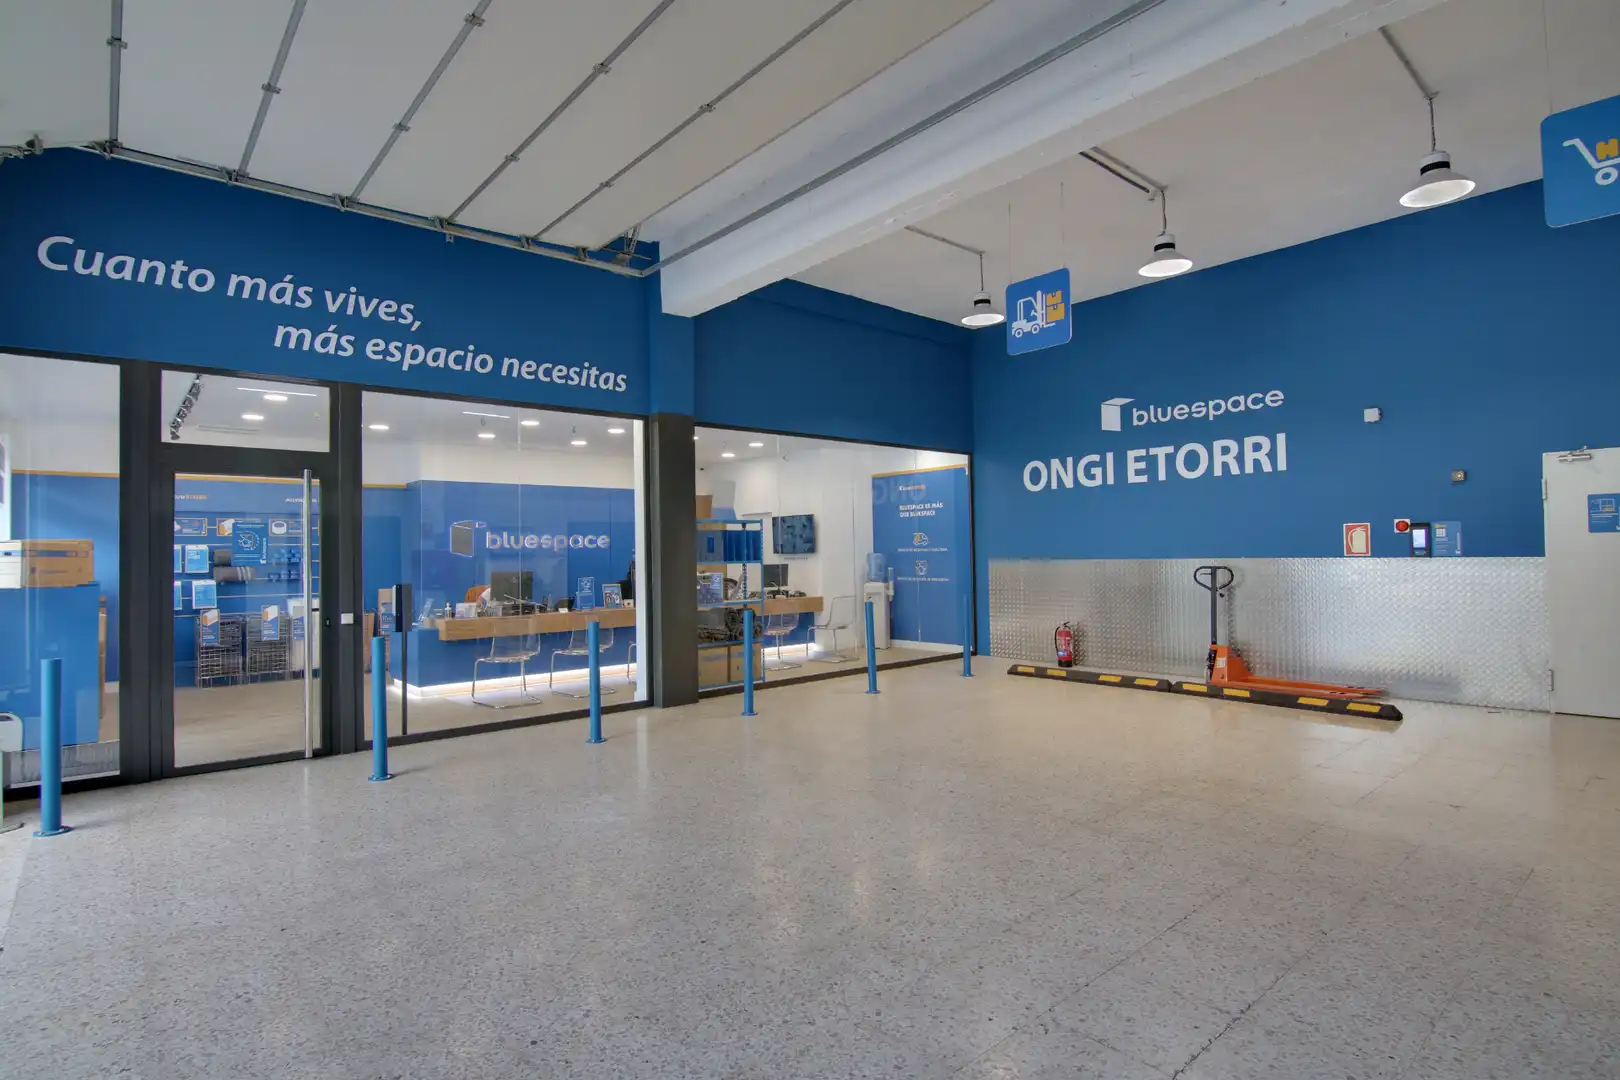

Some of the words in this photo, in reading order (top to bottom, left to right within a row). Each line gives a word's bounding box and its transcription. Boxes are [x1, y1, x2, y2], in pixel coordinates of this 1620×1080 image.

[37, 235, 216, 293] Cuanto
[226, 274, 314, 309] más
[324, 286, 422, 332] vives,
[273, 324, 356, 357] más
[365, 338, 494, 374] espacio
[501, 356, 628, 393] necesitas
[1132, 389, 1285, 426] bluespace
[1022, 451, 1116, 493] ONGI
[1126, 432, 1288, 484] ETORRI
[486, 531, 610, 553] bluespace
